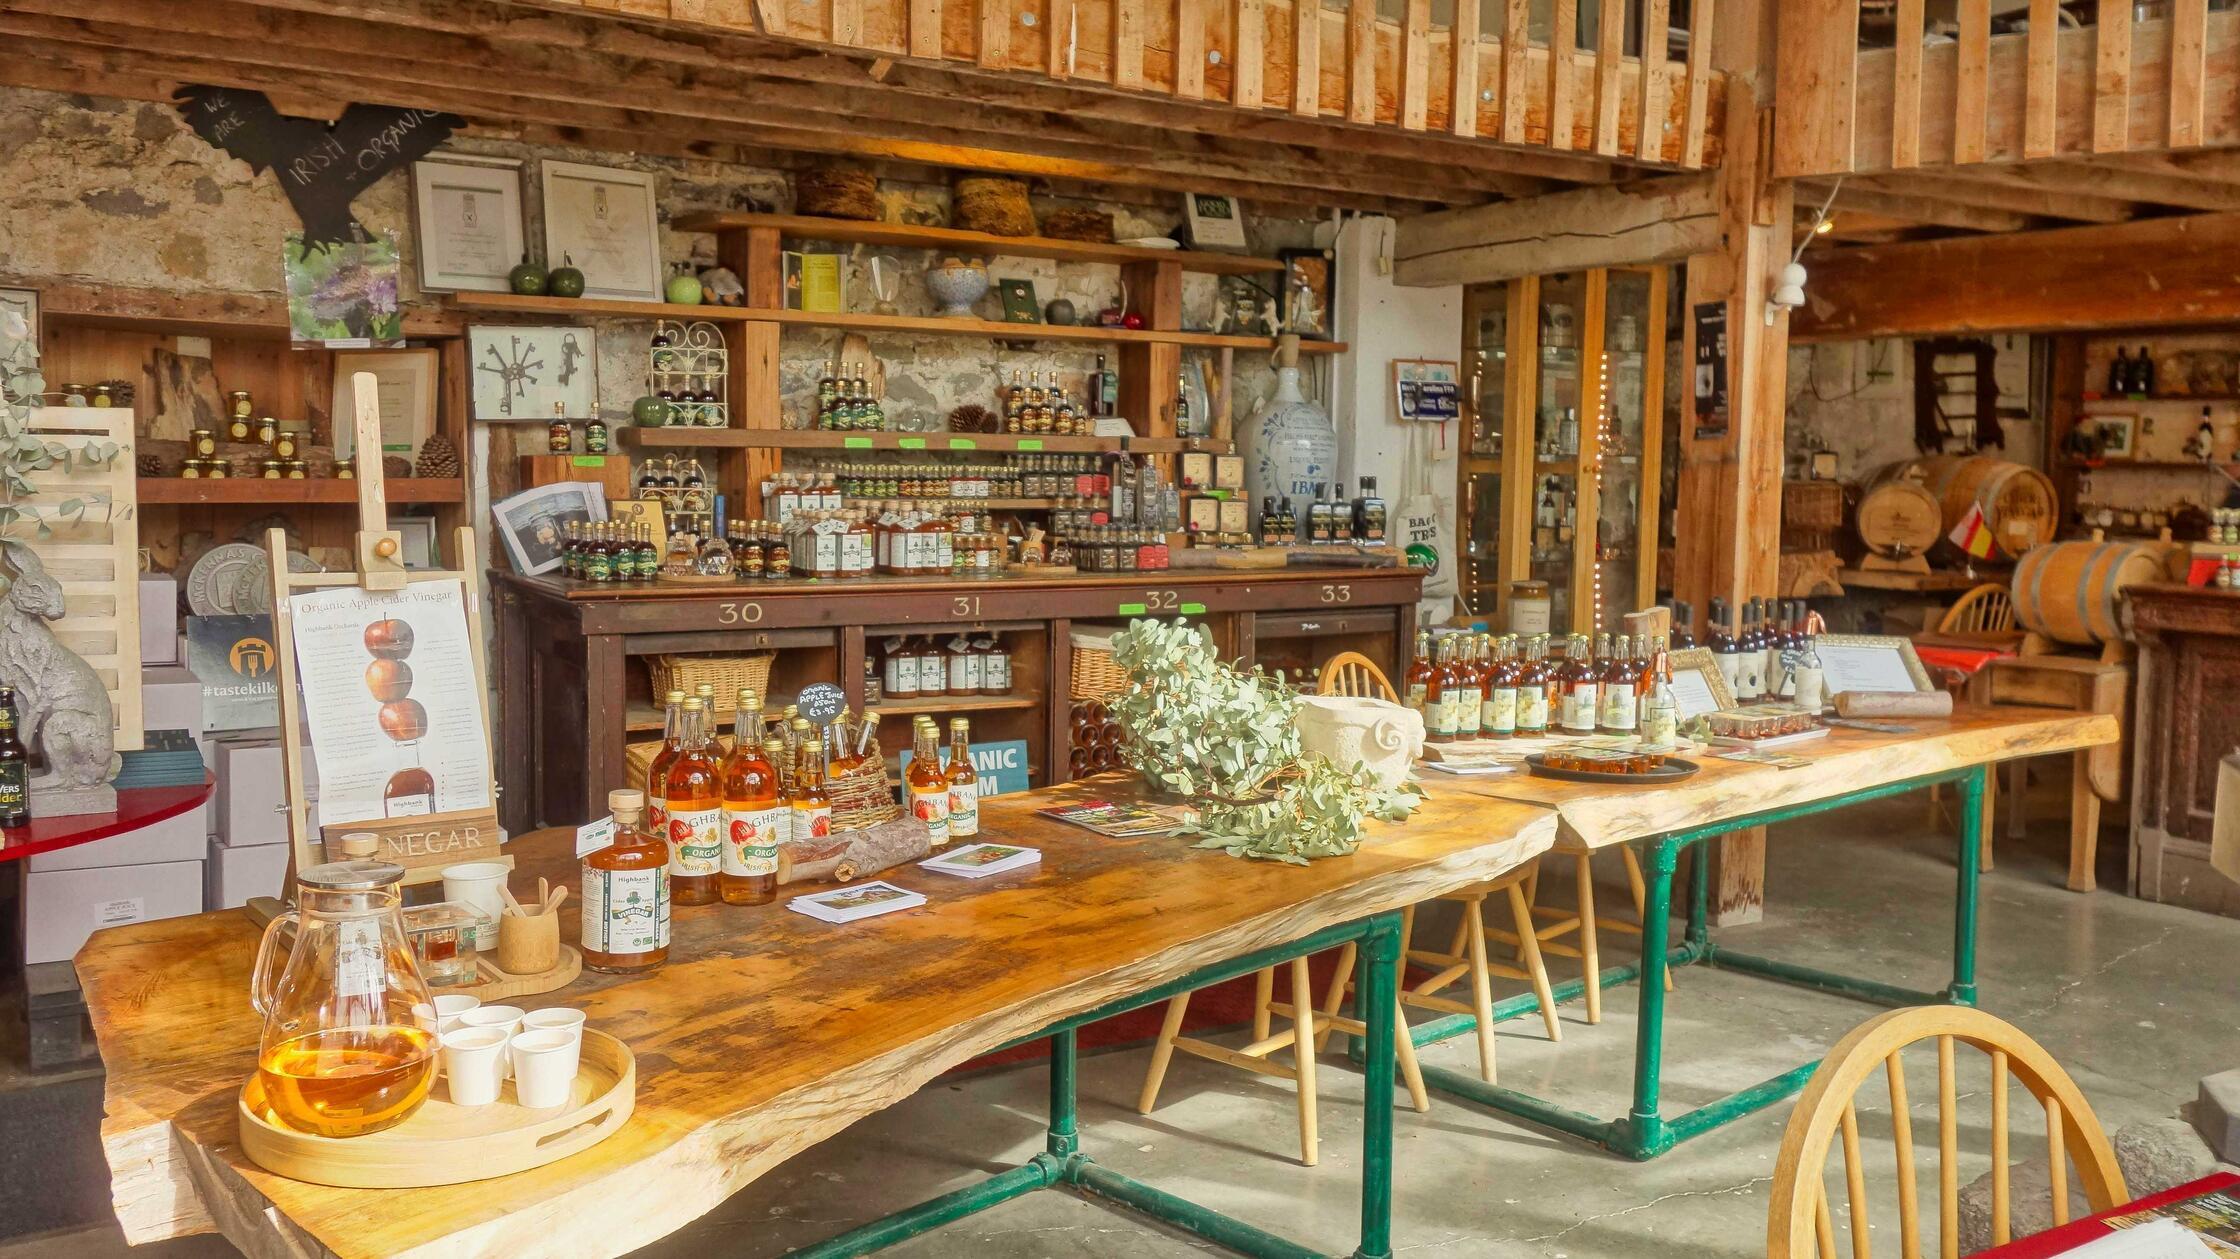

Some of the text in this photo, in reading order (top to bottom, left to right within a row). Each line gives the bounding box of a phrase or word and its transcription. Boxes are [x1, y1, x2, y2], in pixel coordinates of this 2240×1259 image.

[204, 92, 231, 114] WE
[214, 110, 246, 142] ARE
[357, 109, 441, 172] ORGANIC
[289, 132, 346, 186] IRISH
[301, 590, 453, 615] Organic Apple Cider Vinegar
[1145, 591, 1178, 609] 32
[1321, 585, 1350, 602] 33
[718, 603, 763, 624] 30
[952, 597, 980, 616] 31
[799, 691, 845, 704] APPLE JUICE
[809, 706, 836, 717] €3.95
[386, 827, 483, 859] NEGAR
[618, 876, 650, 884] Highbank
[618, 906, 649, 919] VINEGAR
